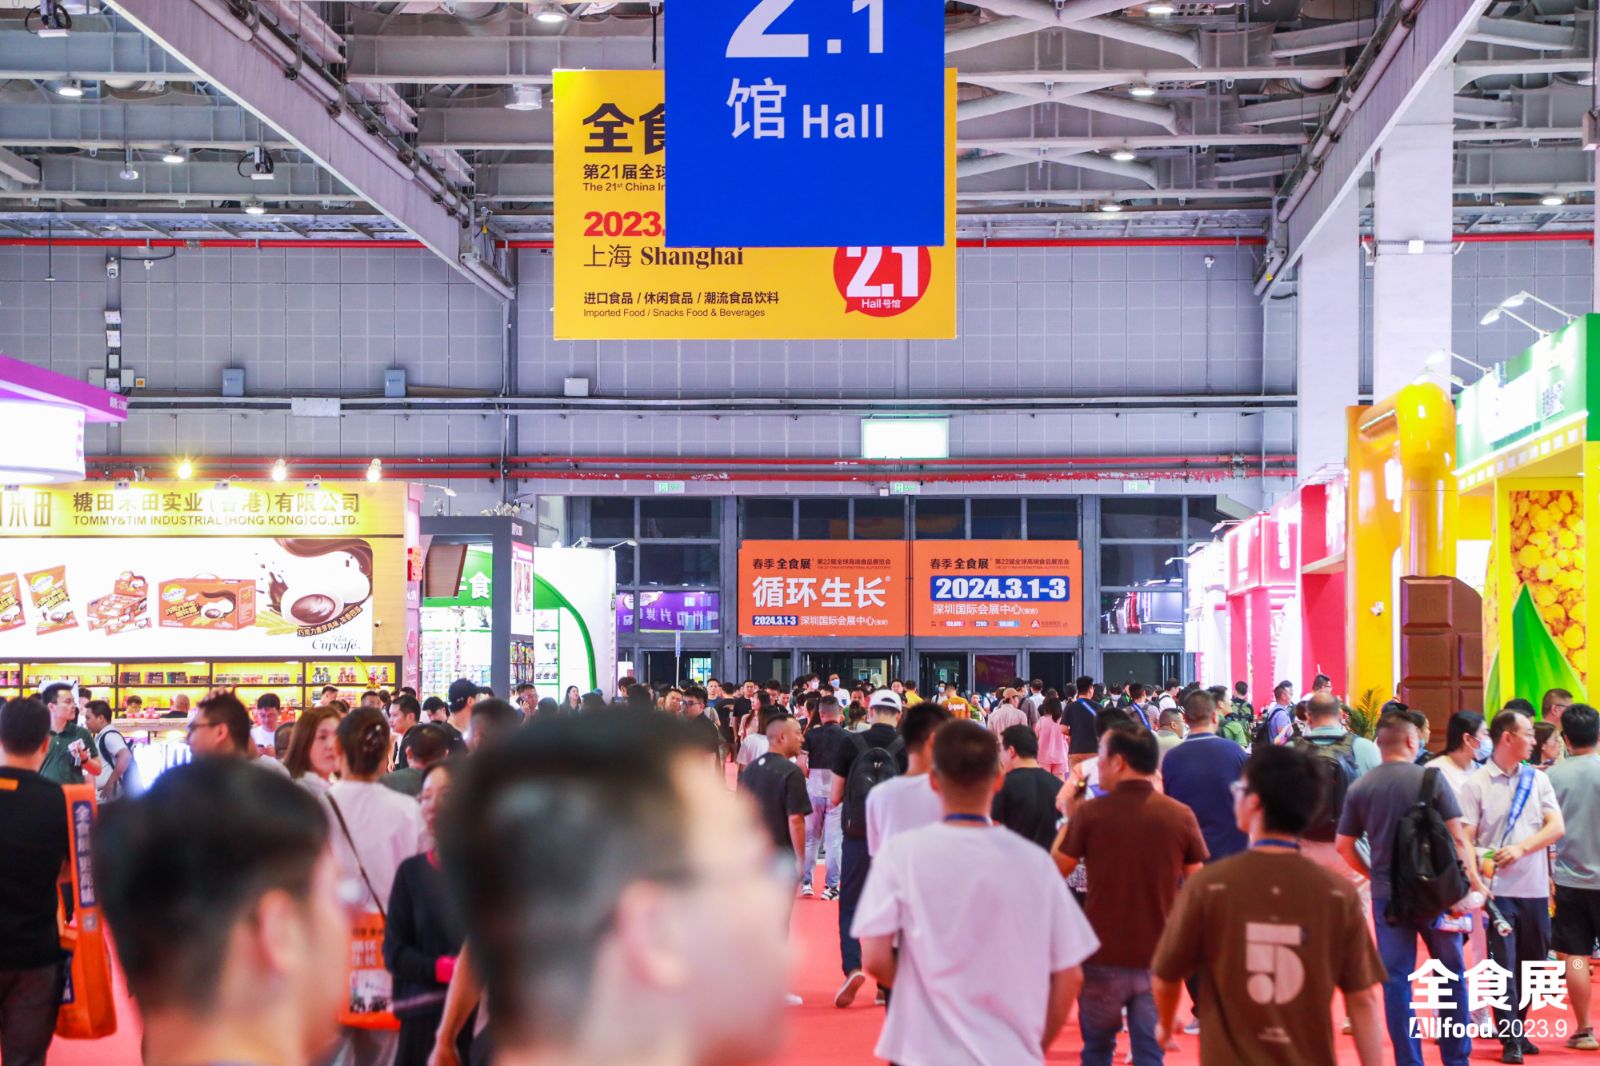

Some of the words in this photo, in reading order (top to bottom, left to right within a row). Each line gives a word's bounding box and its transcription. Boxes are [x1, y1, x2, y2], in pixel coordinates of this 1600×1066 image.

[726, 77, 787, 139] 馆
[802, 103, 884, 138] Hall
[583, 183, 602, 191] The
[625, 183, 654, 191] China
[583, 244, 632, 268] 上海
[640, 246, 743, 269] Shanghai
[846, 246, 919, 297] 2.1
[584, 292, 633, 304] 进口食品
[644, 292, 693, 304] 休闲食品
[704, 292, 779, 304] 潮流食品饮料
[584, 309, 621, 318] Imported
[624, 309, 645, 317] Food
[653, 309, 684, 317] Snacks
[687, 309, 708, 317] Food
[711, 309, 717, 317] &
[720, 309, 765, 318] Beverages
[73, 515, 147, 526] TOMMY&TIM
[150, 515, 221, 525] INDUSTRIAL
[752, 576, 887, 608] 循环生长
[935, 577, 1066, 599] 2024.3.1-3
[754, 616, 796, 625] 2024.3.1-3
[1246, 922, 1305, 1005] 5
